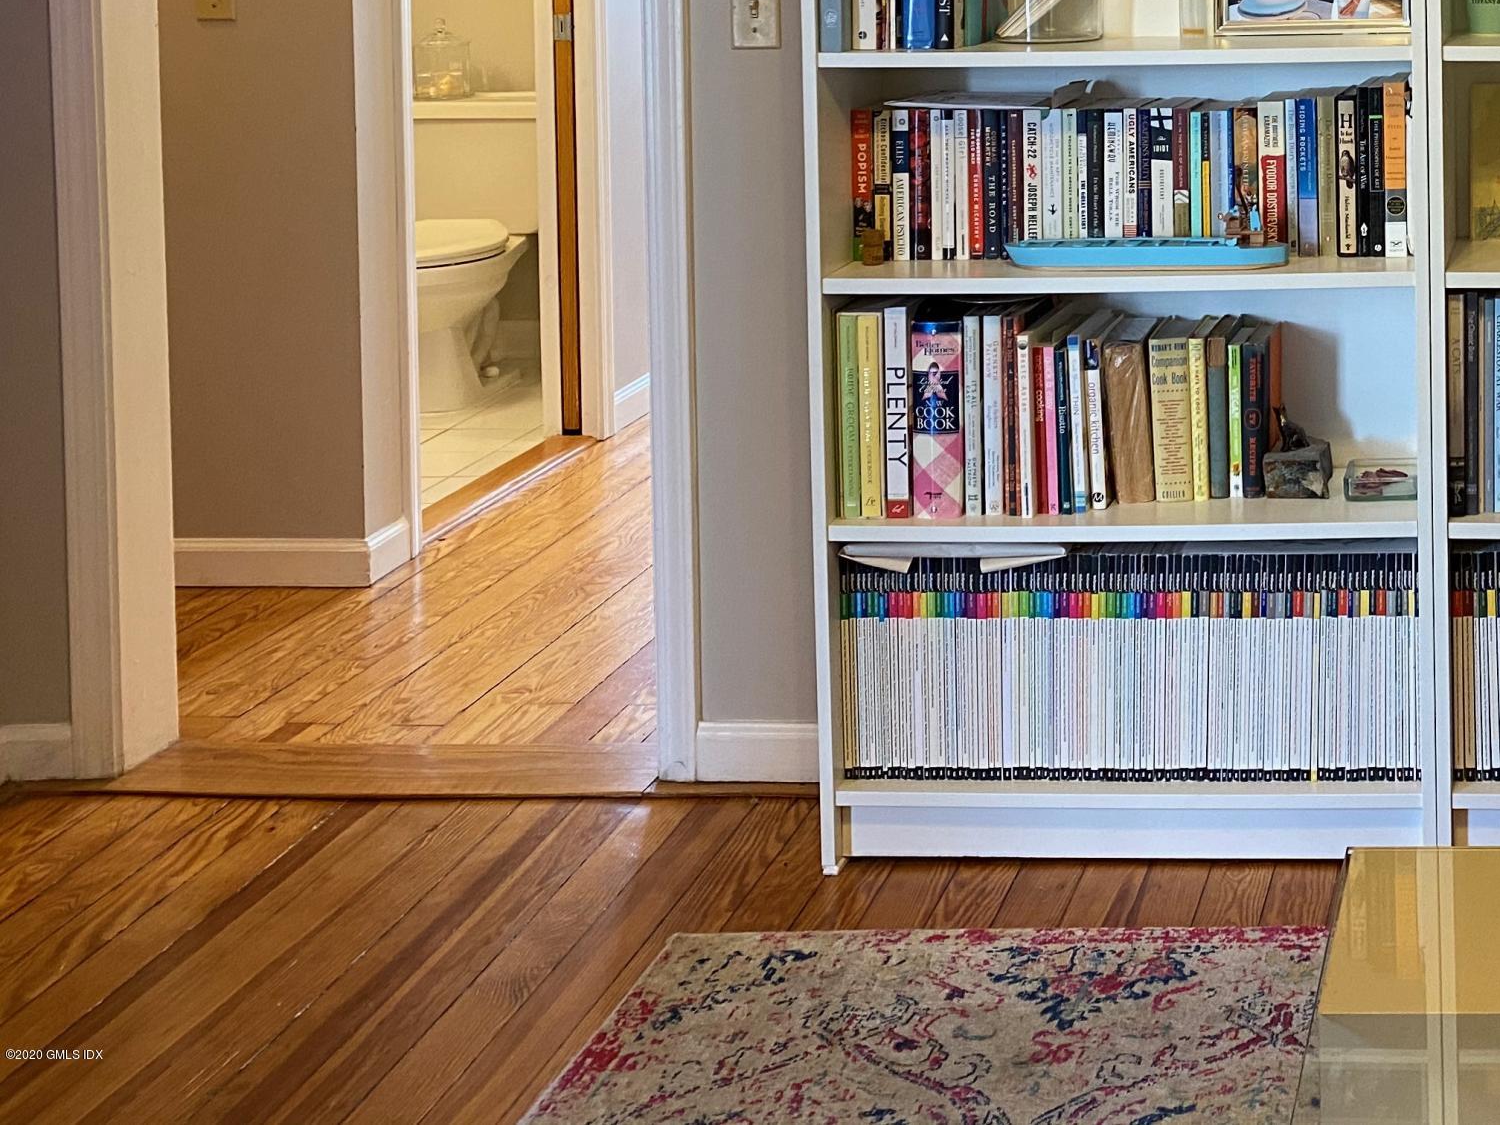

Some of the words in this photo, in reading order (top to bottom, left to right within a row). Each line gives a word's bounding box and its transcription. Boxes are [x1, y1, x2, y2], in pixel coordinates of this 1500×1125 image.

[878, 117, 889, 143] Kitchen
[1128, 113, 1137, 138] UGLY
[1298, 105, 1307, 134] RIDING
[895, 140, 905, 165] ELLIS
[1026, 122, 1037, 159] CATCH-22
[1298, 136, 1307, 171] ROCKETS
[855, 143, 867, 194] POPISM
[878, 144, 889, 184] Confidential
[1128, 140, 1137, 194] AMERICANS
[1265, 159, 1279, 191] FYODOR
[895, 177, 906, 222] AMERICAN
[988, 175, 997, 198] THE
[1026, 182, 1037, 212] JOSEPH
[988, 202, 997, 233] ROAD
[1265, 192, 1279, 244] DOSTOEVSKY
[895, 224, 906, 257] PSYCHO
[1152, 373, 1168, 386] Cook
[1171, 373, 1187, 386] Book
[915, 406, 955, 418] COOK
[1087, 381, 1097, 418] organic
[886, 366, 907, 468] PLENTY
[916, 418, 956, 430] BOOK
[1059, 405, 1067, 434] Risotto
[1090, 420, 1100, 455] kitchen
